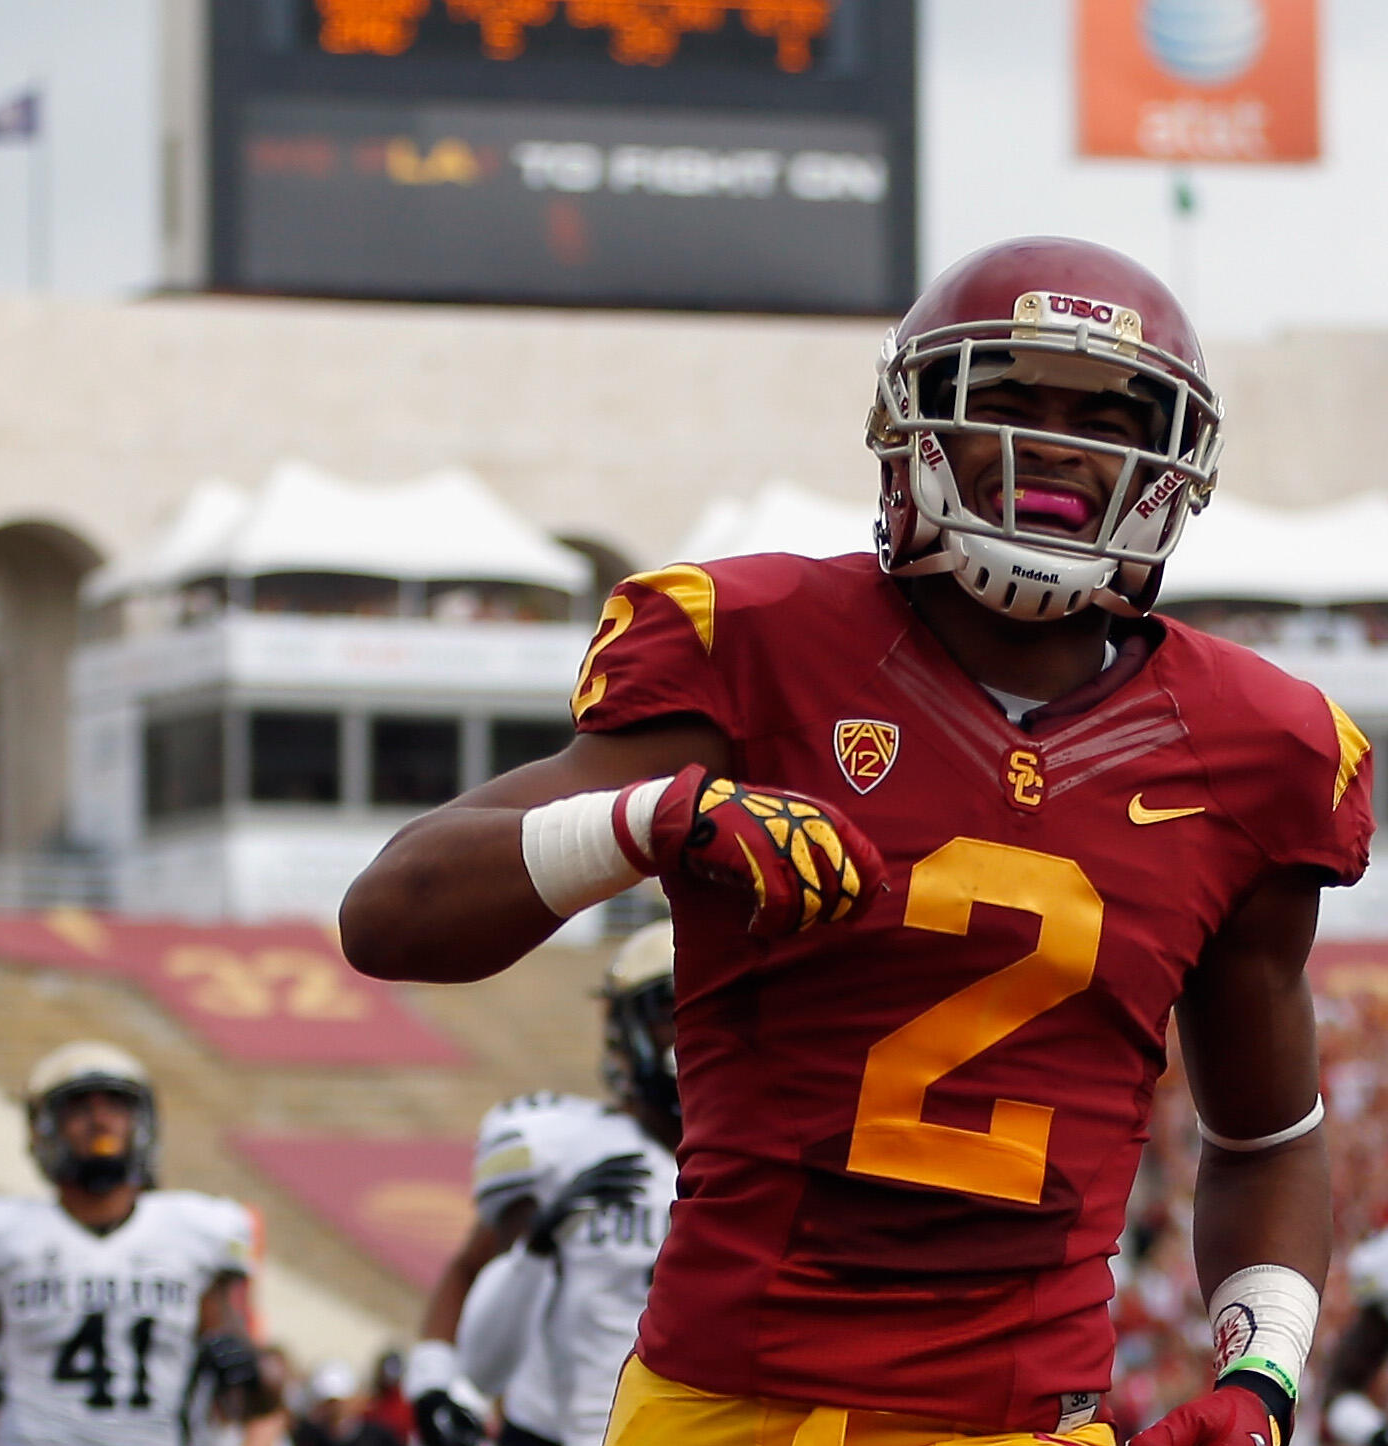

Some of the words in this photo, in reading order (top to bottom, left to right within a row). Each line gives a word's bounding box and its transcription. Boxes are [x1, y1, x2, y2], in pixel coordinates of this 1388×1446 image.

[1049, 295, 1112, 324] USC
[571, 595, 635, 722] 2
[838, 722, 895, 763] PAC
[850, 750, 880, 779] 12
[1007, 750, 1043, 807] SC
[846, 837, 1104, 1205] 2
[52, 1311, 156, 1410] 41
